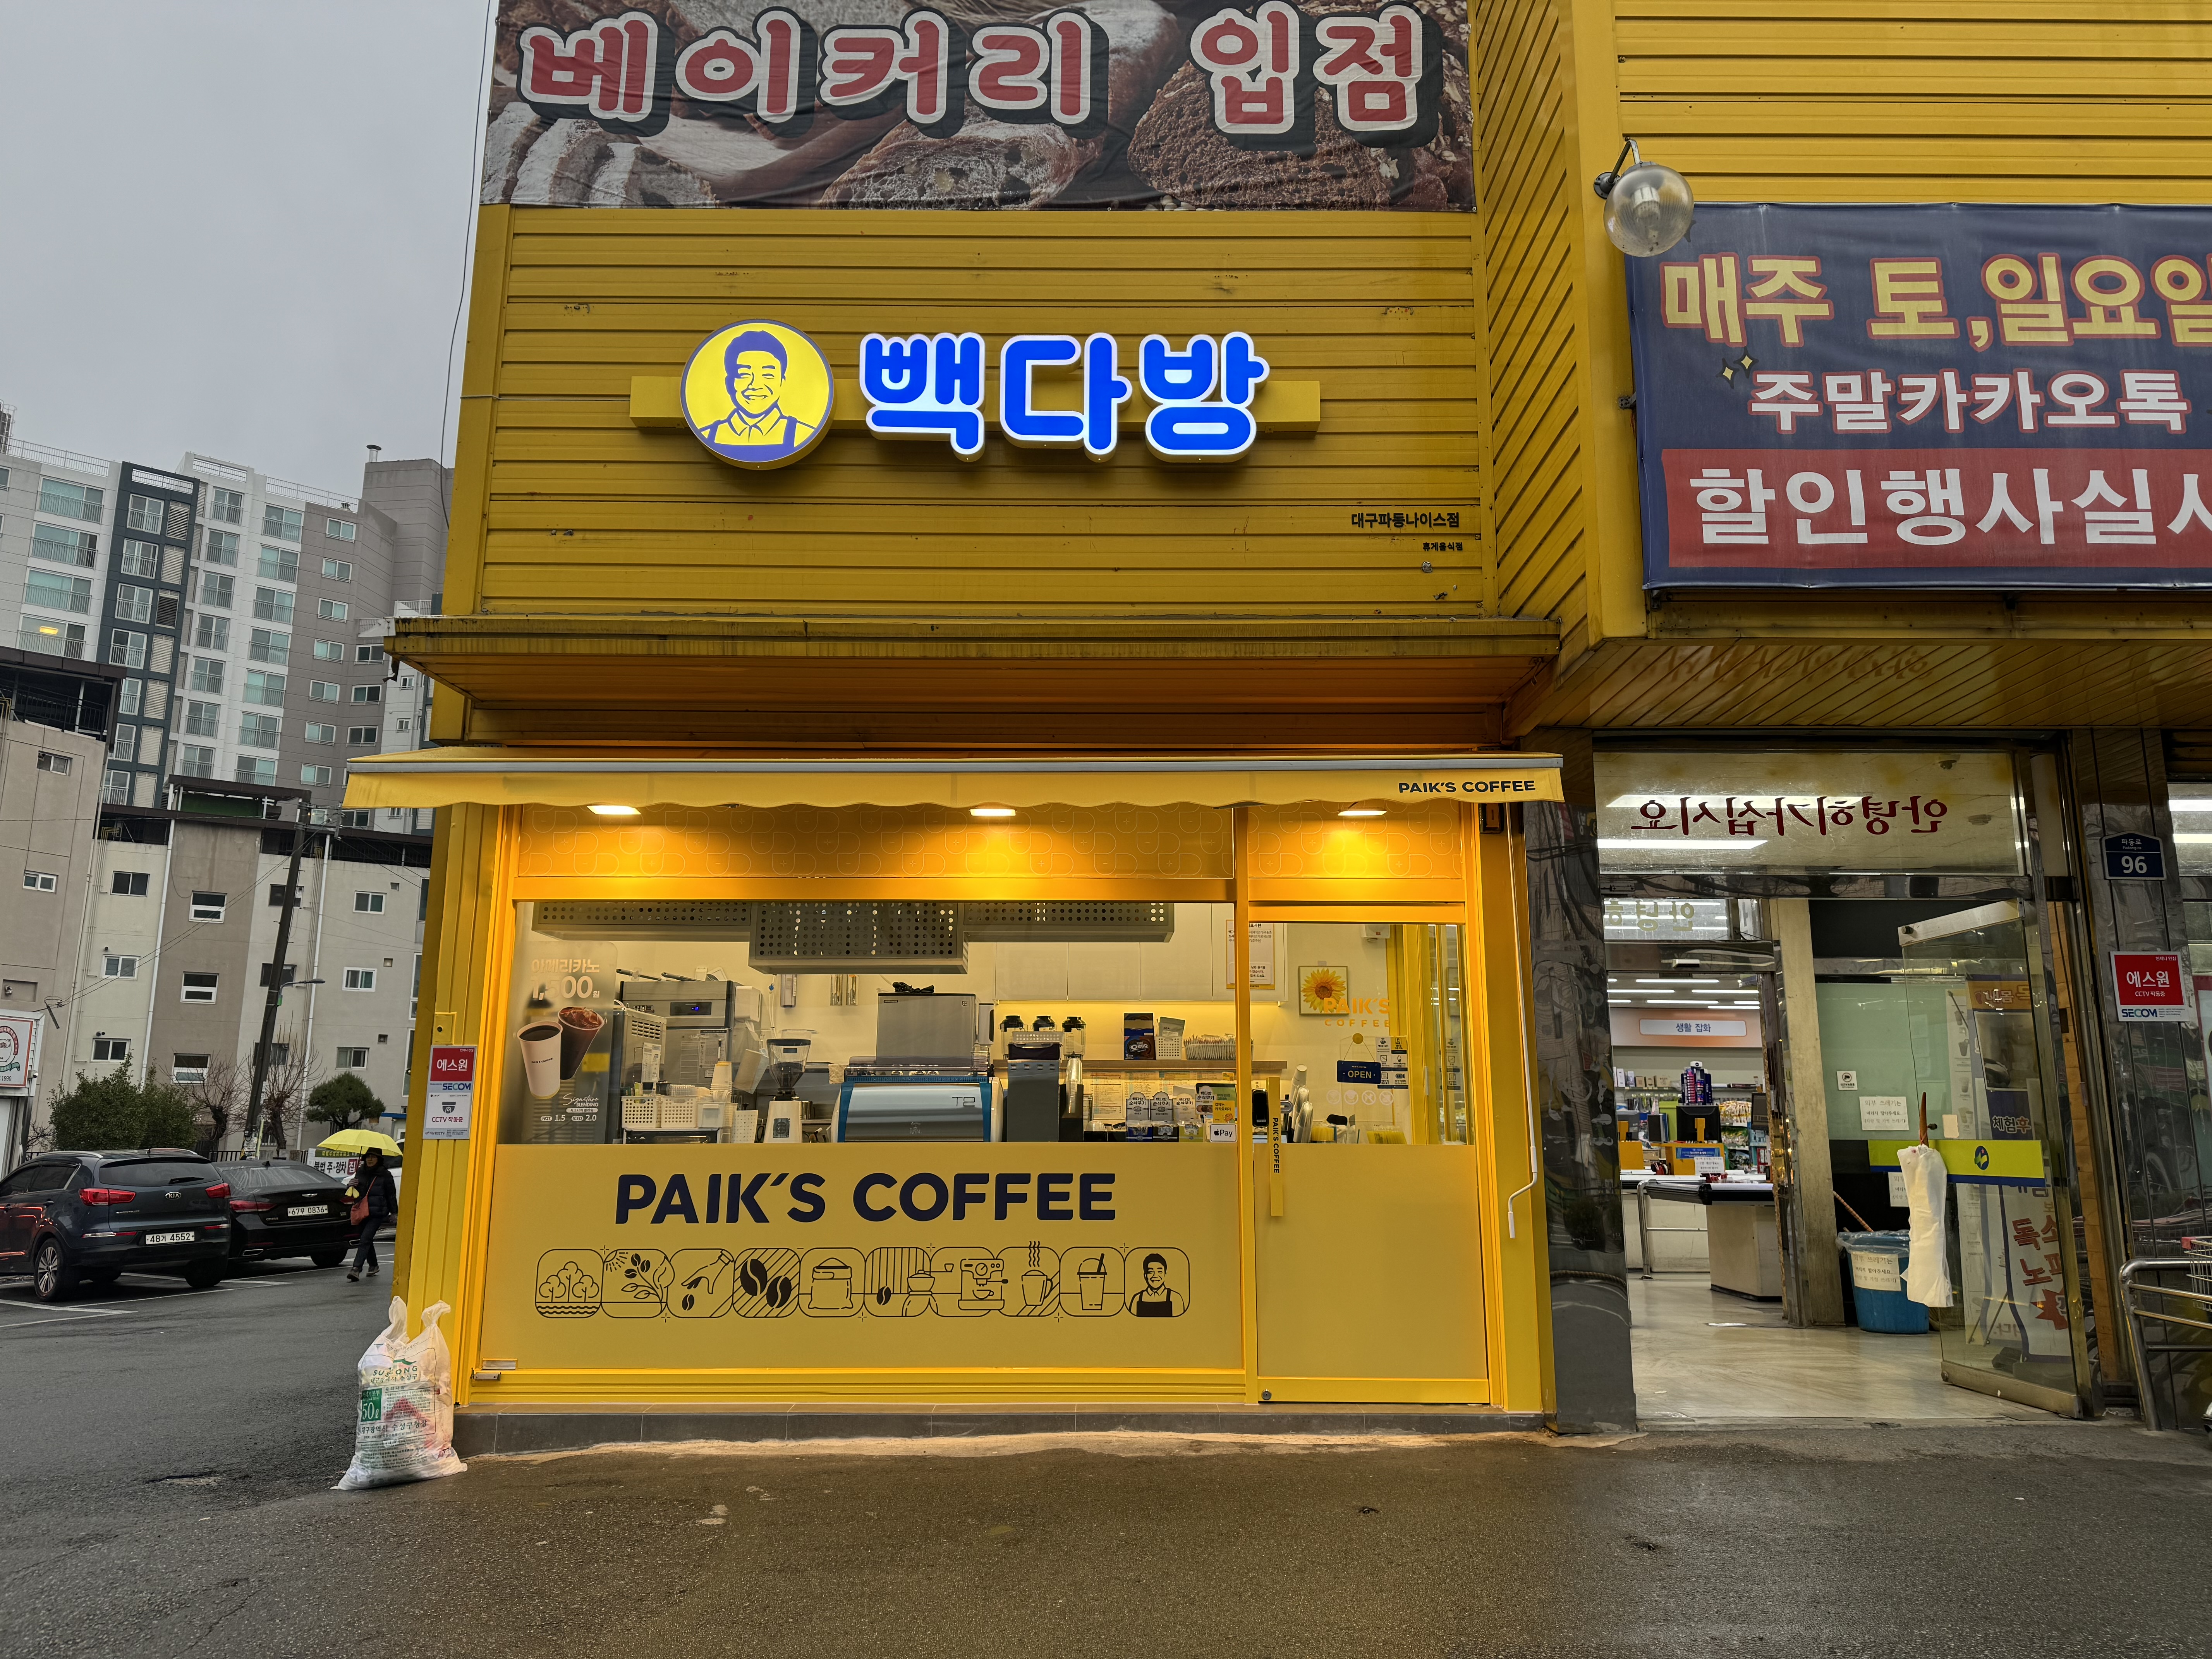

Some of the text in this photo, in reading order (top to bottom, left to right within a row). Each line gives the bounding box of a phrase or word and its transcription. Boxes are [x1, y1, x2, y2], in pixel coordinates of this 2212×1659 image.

[517, 0, 1420, 136] 베이커리 입점
[1660, 252, 1835, 347] 매주
[859, 332, 1271, 463] 빽다방
[1749, 368, 2192, 434] 주말카카오톡
[1351, 512, 1459, 528] 대구파동나이스점
[1422, 542, 1463, 551] 휴게음식점
[1398, 780, 1535, 793] PAIK'S COFFEE
[2121, 855, 2147, 874] 96
[532, 959, 600, 973] 아메리카노
[2126, 971, 2170, 988] 에스원
[1323, 997, 1390, 1015] PAIK'S
[2121, 1008, 2158, 1018] SECOM
[1324, 1018, 1390, 1027] COFFEE
[1676, 1023, 1711, 1032] 생활 잡화
[436, 1058, 468, 1071] 에스원
[1347, 1070, 1372, 1079] OPEN
[562, 1093, 599, 1106] Signature
[951, 1096, 975, 1107] T2
[1992, 1115, 2032, 1134] 체험후
[1220, 1129, 1233, 1138] Pay
[314, 1161, 325, 1173] 불법
[615, 1172, 1116, 1224] PAIK'S COFFEE
[150, 1233, 191, 1243] 48거 4552
[399, 1374, 418, 1382] 수성구
[361, 1419, 428, 1434] 대구광역시 수성구청장
